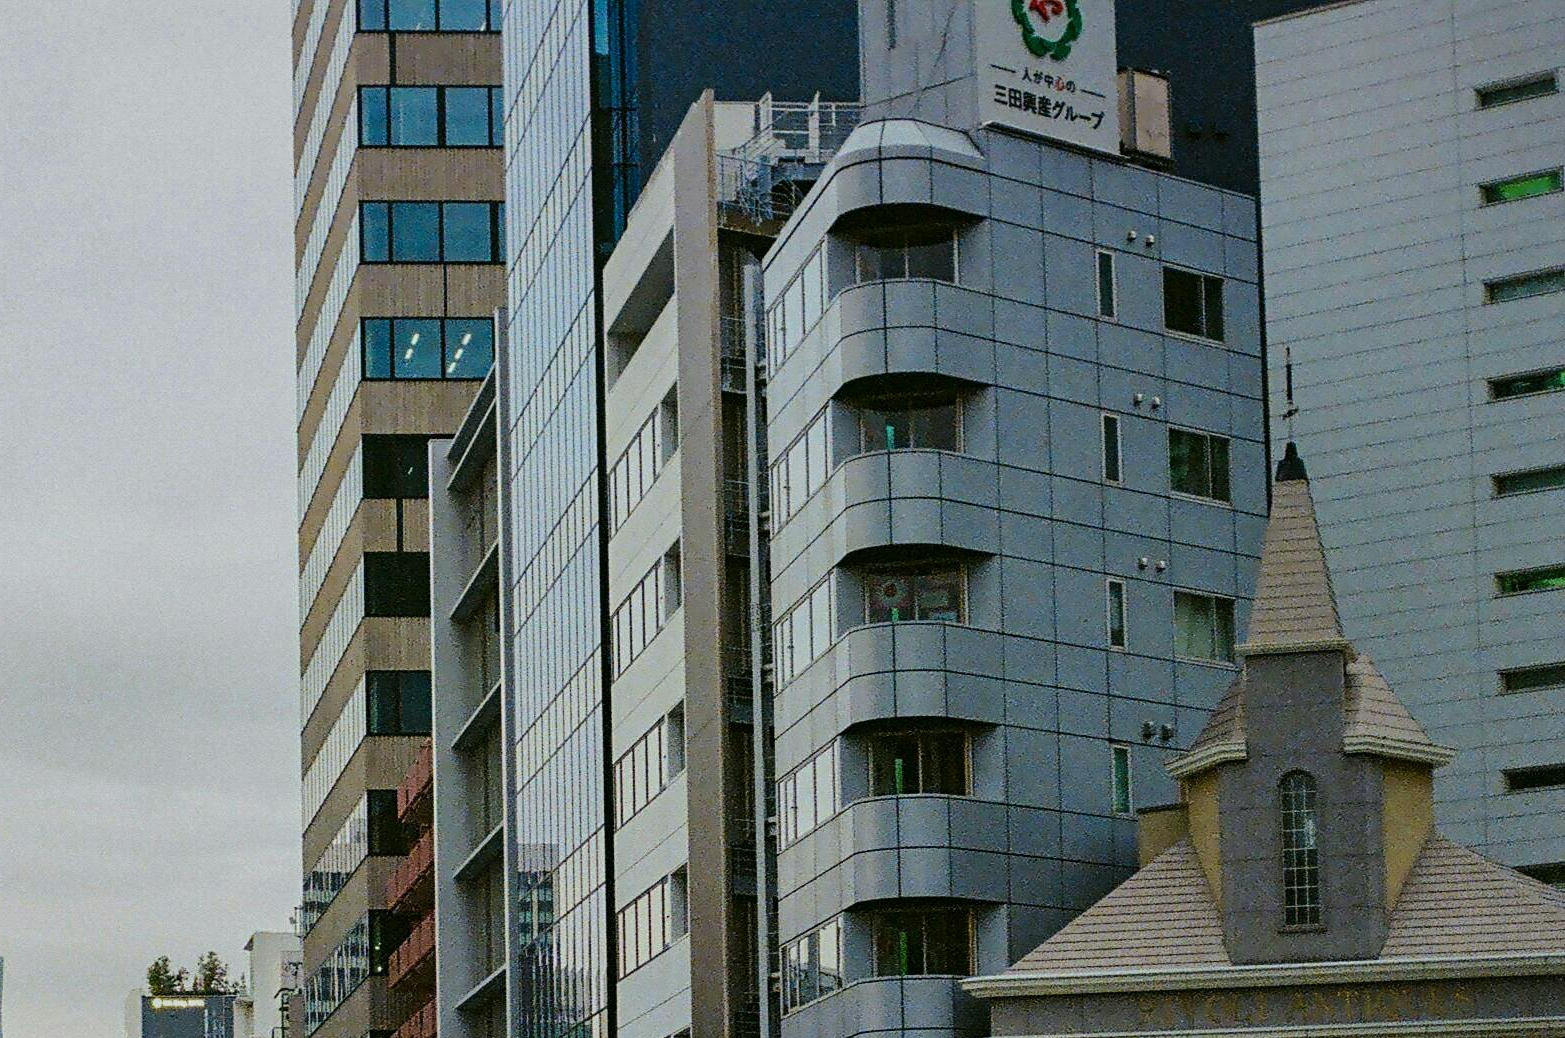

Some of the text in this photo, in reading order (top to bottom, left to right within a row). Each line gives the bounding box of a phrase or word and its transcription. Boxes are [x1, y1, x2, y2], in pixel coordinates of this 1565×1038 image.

[1022, 67, 1076, 94] 人が中心の
[994, 84, 1105, 130] 三田興産グループ
